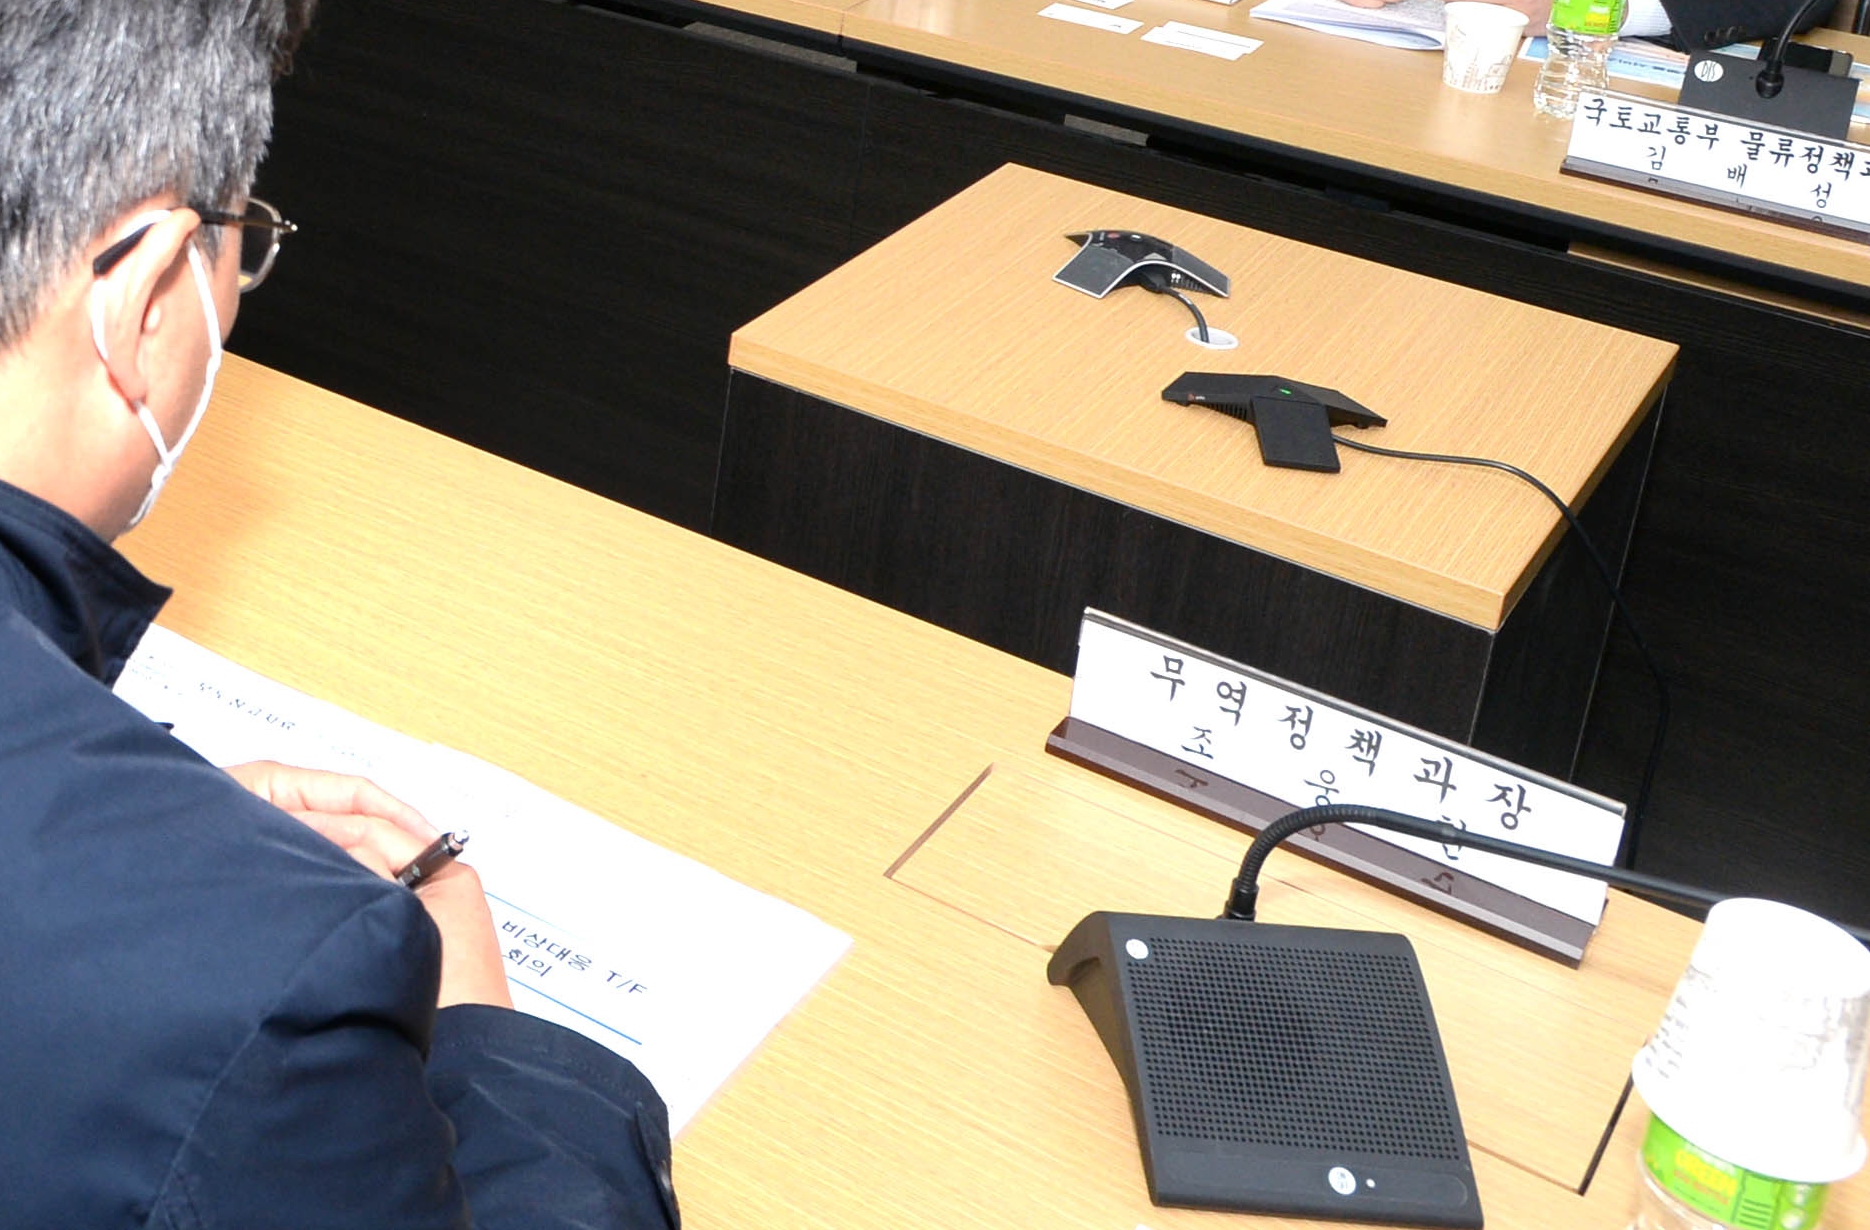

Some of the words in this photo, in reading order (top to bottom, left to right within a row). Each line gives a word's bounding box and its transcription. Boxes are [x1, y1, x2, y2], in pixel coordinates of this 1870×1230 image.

[1583, 97, 1720, 150] 국토교통부
[1646, 145, 1667, 171] 김
[1726, 163, 1749, 189] 배
[1810, 182, 1832, 209] 성
[1149, 653, 1535, 833] 무역정책과장
[1180, 725, 1215, 761] 조
[1303, 769, 1340, 807] 웅
[501, 920, 593, 971] 비상대응
[606, 969, 649, 995] T/F
[502, 948, 553, 978] 회의
